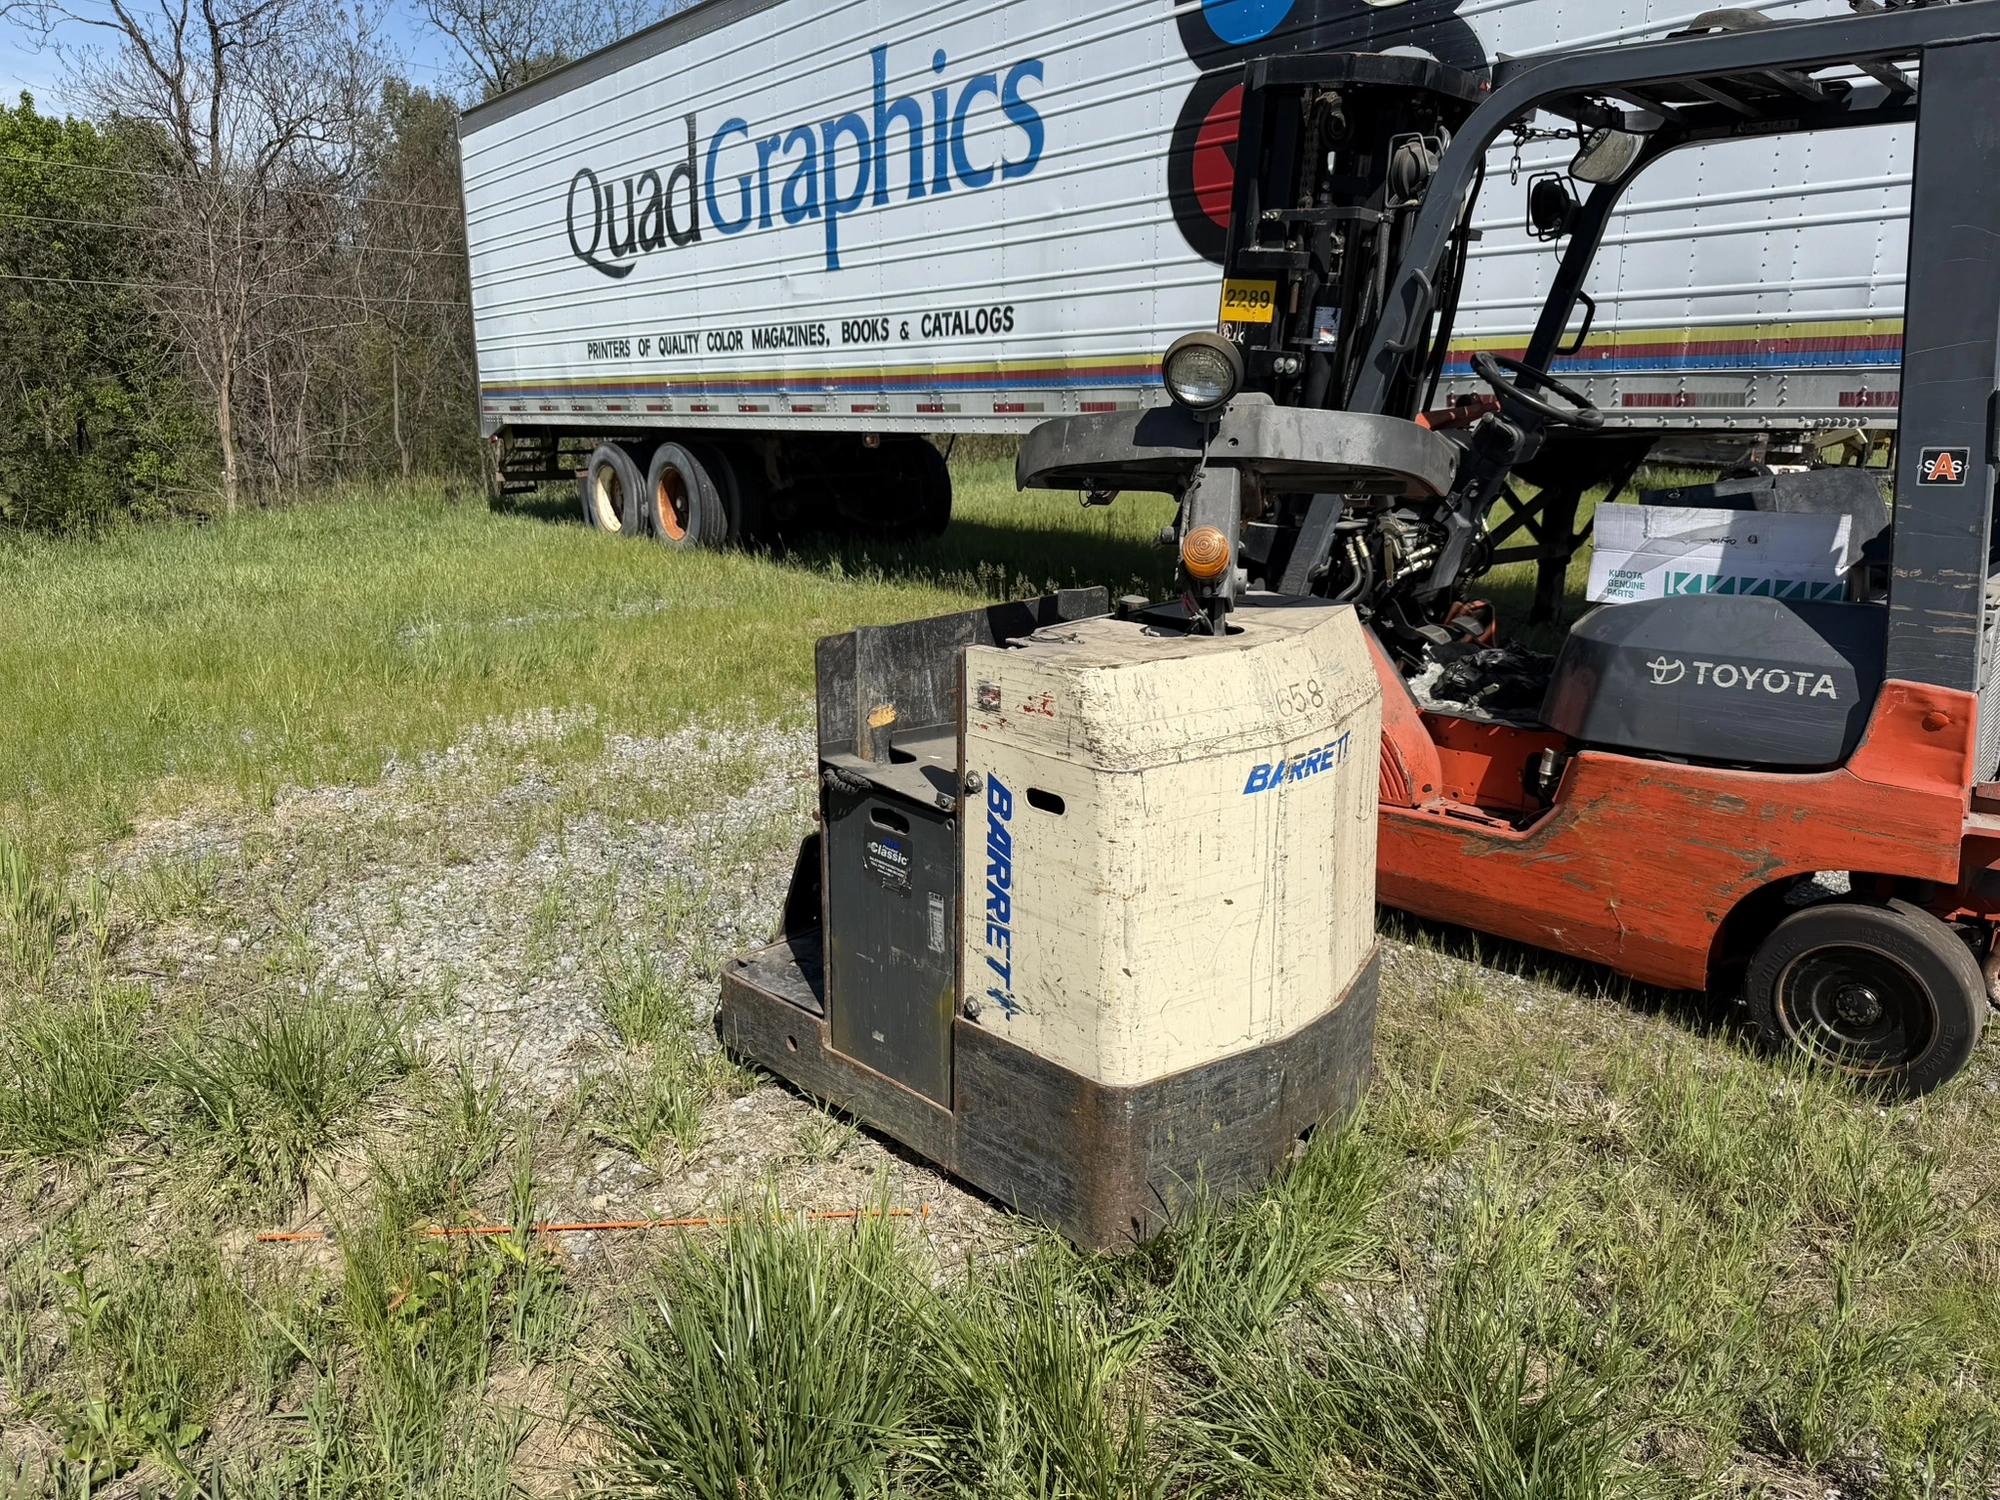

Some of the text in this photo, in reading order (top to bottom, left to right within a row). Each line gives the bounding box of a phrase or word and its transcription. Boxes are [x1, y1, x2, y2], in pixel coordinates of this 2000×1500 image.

[1225, 289, 1271, 309] 2289
[587, 306, 1015, 360] PRINTERS OF QUALITY COLOR MAGAZINES, BOOKS & CATALOGS
[1923, 452, 1963, 481] SAS
[1608, 580, 1645, 591] GENUINE
[1609, 569, 1643, 580] KUBOTA
[1607, 588, 1635, 599] PARTS
[1693, 661, 1837, 699] TOYOTA
[1276, 679, 1323, 717] 658
[1243, 729, 1351, 795] BARRETT
[870, 841, 908, 866] Classic
